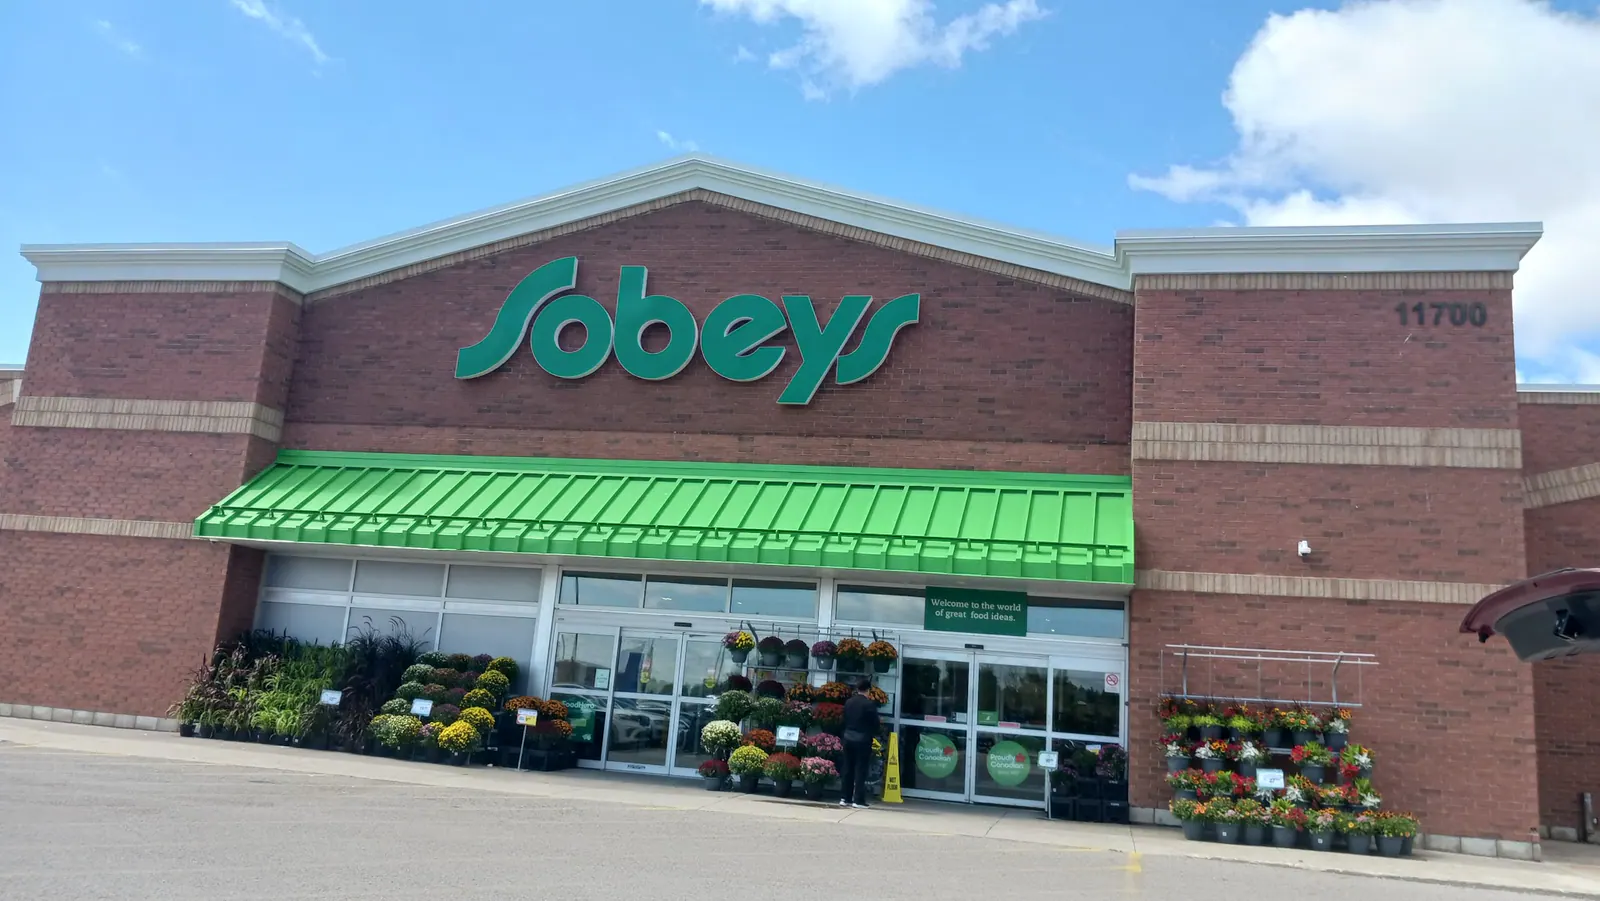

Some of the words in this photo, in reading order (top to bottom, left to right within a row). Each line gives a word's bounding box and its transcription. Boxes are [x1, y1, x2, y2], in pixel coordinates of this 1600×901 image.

[1395, 301, 1487, 326] 11700
[454, 256, 921, 405] Sobeys
[931, 599, 969, 608] Welcome
[981, 602, 995, 610] the
[970, 611, 989, 619] food
[991, 613, 1016, 621] ideas.
[919, 746, 943, 754] Proudly
[919, 754, 951, 762] Canadian
[990, 753, 1016, 762] Proudly
[990, 761, 1024, 769] Canadian
